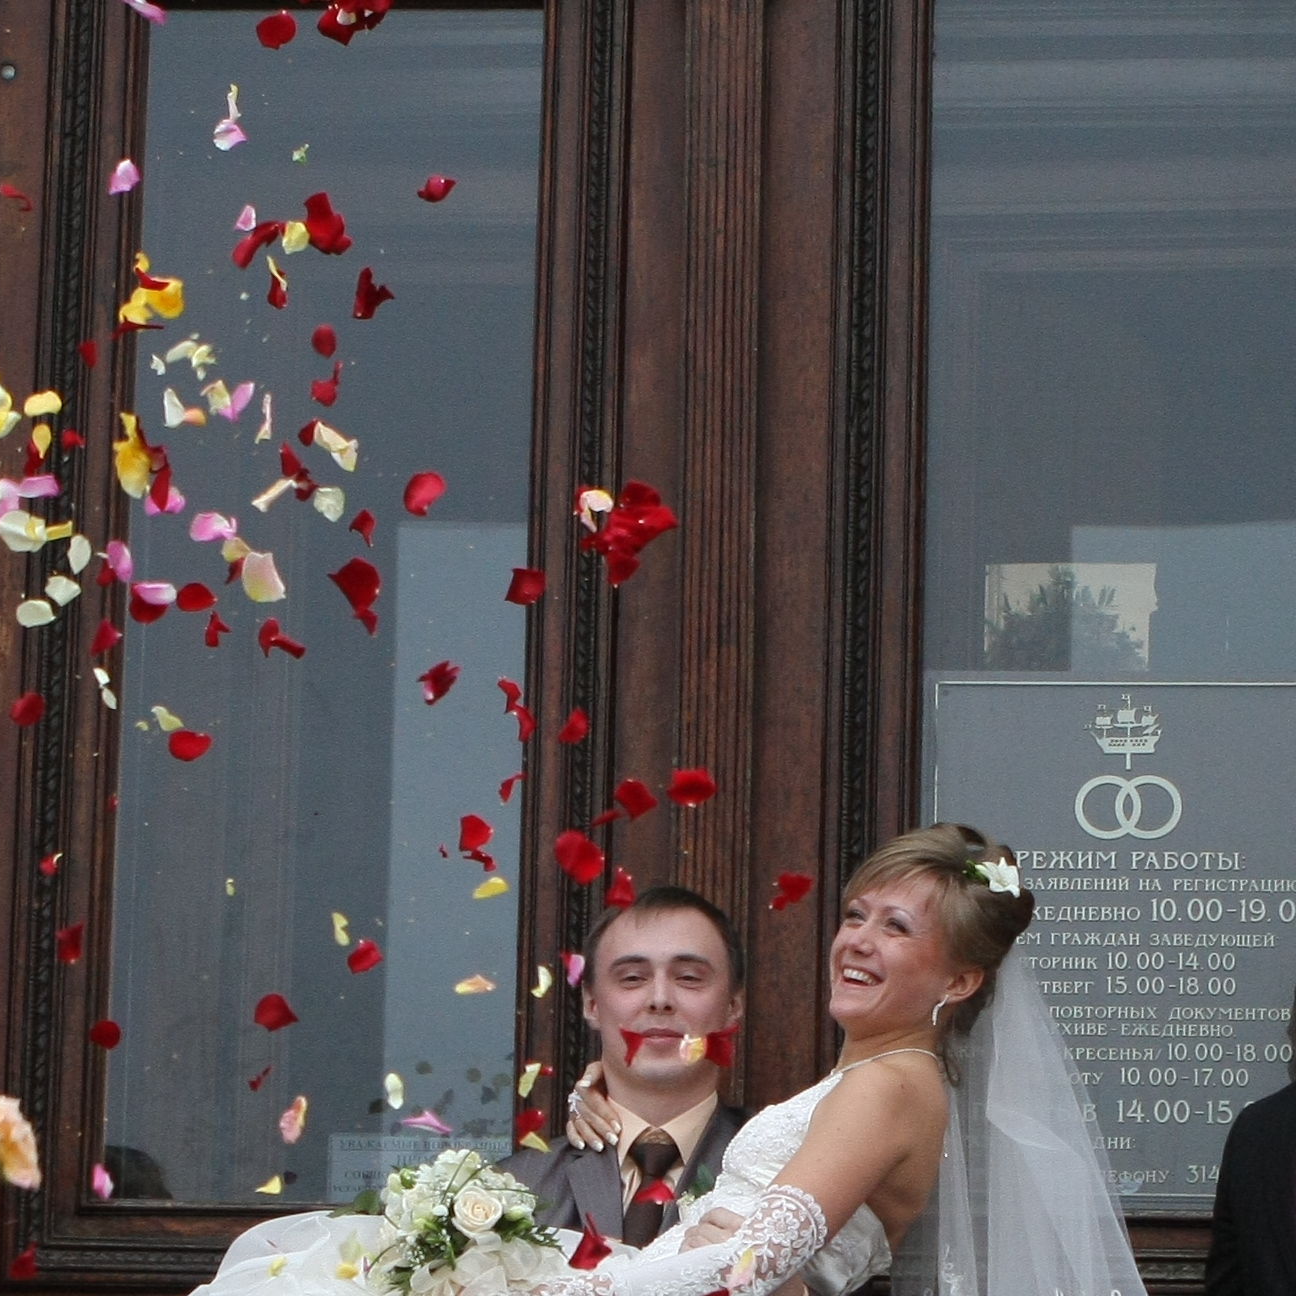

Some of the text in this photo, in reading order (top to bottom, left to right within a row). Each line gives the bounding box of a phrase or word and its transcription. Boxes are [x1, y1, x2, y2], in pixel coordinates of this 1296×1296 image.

[1014, 850, 1246, 872] РЕЖИМ РАБОТЫ:
[1022, 875, 1130, 892] ЗАЯВЛЕНИЙ
[1137, 877, 1163, 892] НА
[1050, 932, 1141, 948] ГРАЖДАН
[1021, 951, 1237, 971] ТОРНИК 10.00-14.00
[1035, 976, 1237, 995] ТВЕРГ 15.00-18.00
[1049, 1005, 1292, 1023] ПОВТОРНЫХ ДОКУМЕНТОВ
[1118, 1067, 1250, 1088] 10.00-17.00
